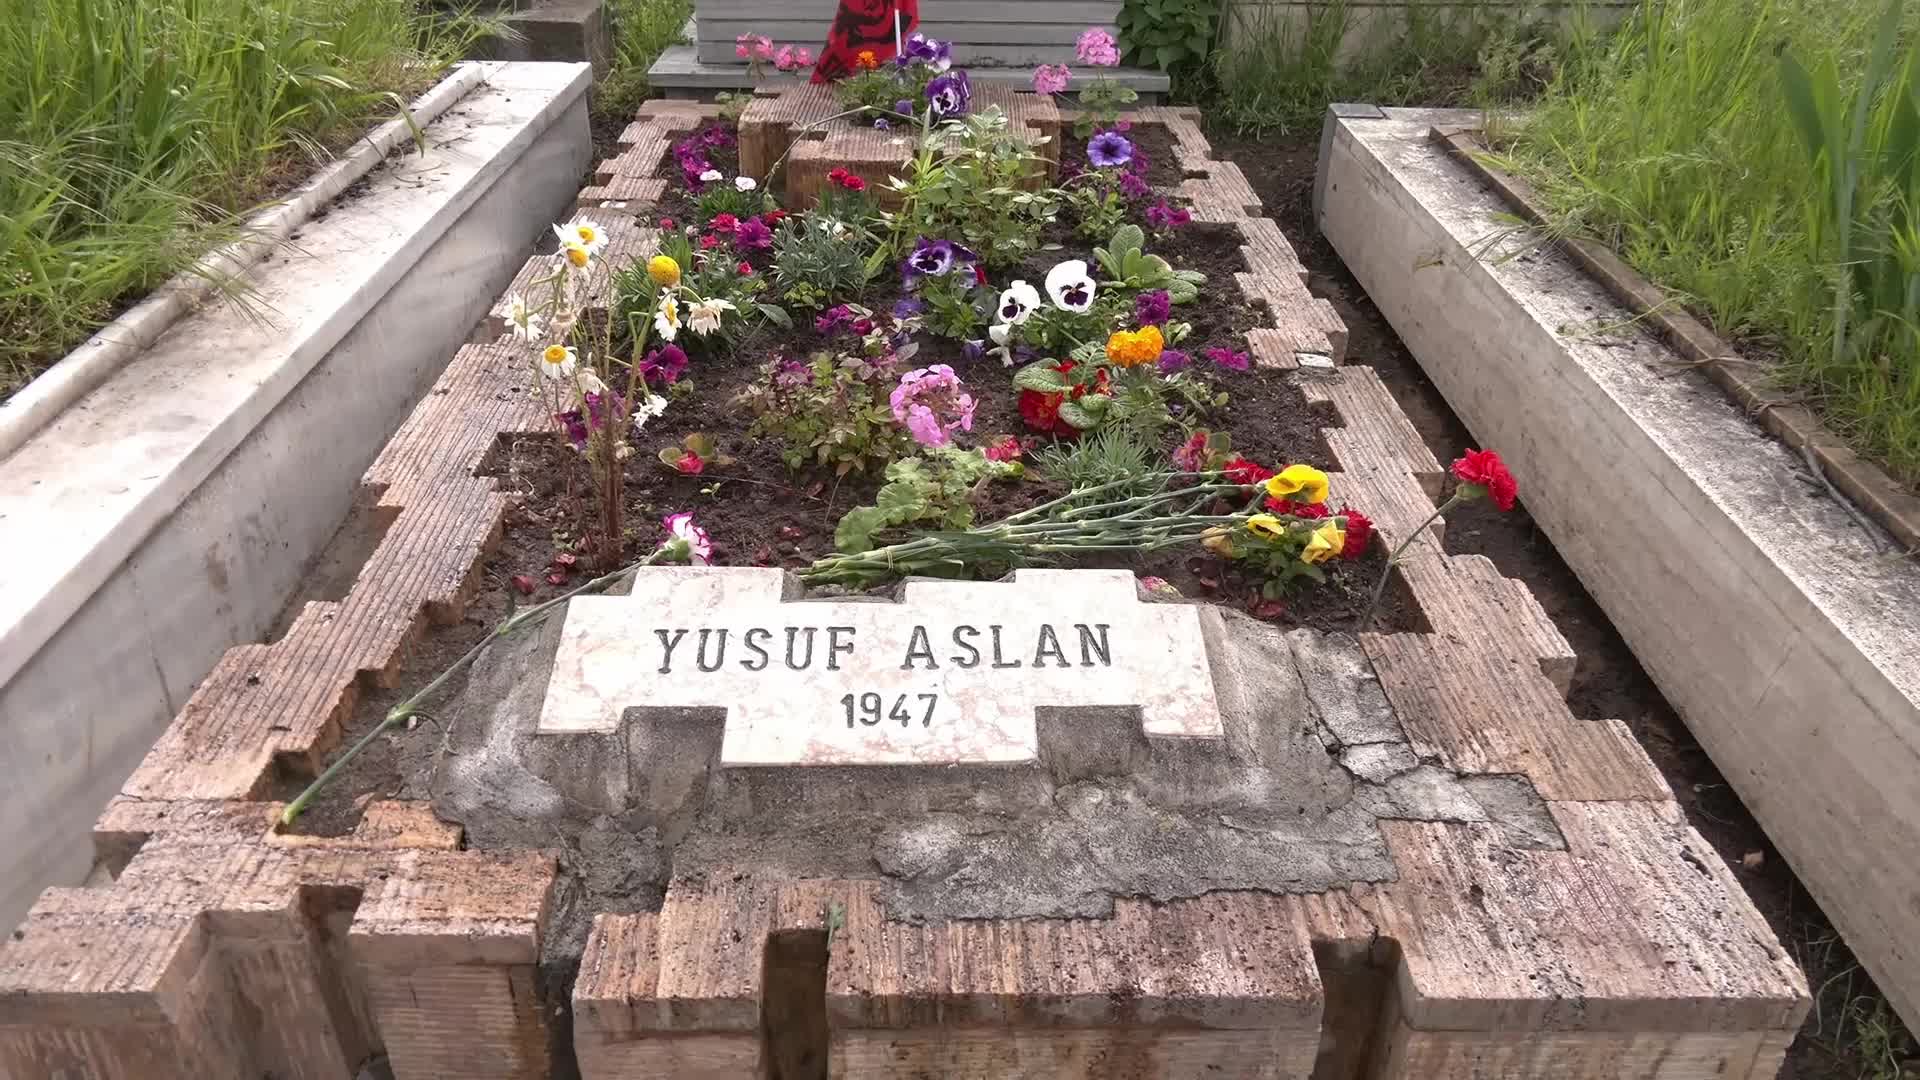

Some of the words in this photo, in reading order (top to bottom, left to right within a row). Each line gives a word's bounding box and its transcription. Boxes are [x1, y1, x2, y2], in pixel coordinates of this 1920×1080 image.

[654, 627, 856, 674] YUSUF
[900, 624, 1112, 670] ASLAN
[840, 692, 938, 728] 1947
